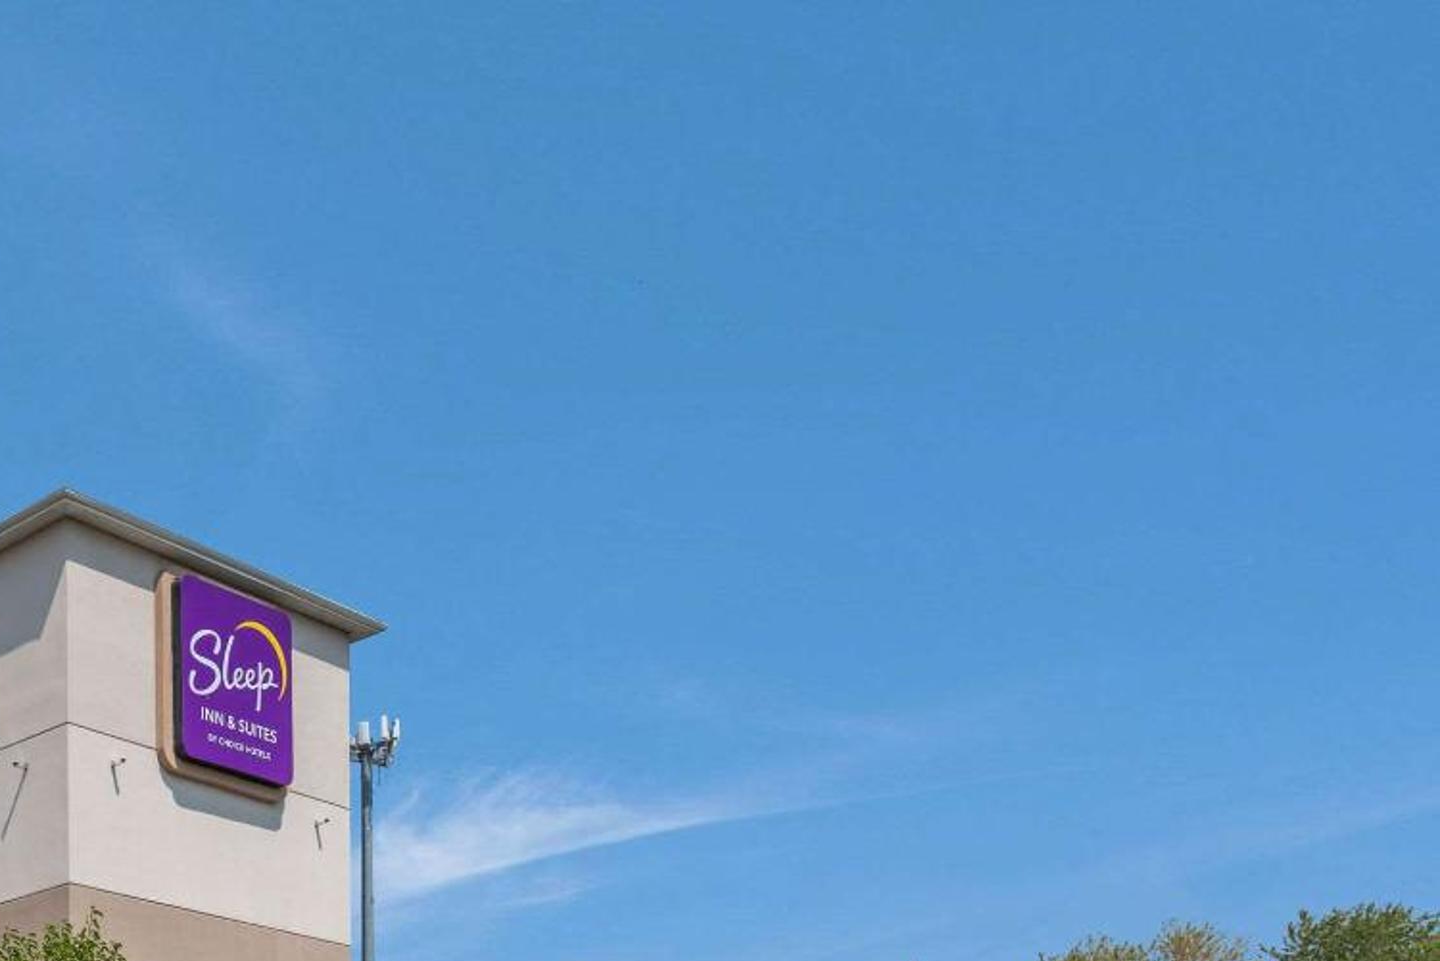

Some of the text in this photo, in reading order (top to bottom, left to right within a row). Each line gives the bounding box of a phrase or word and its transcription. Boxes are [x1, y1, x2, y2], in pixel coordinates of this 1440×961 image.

[188, 628, 279, 712] Sleep
[201, 705, 278, 745] INN & SUITES
